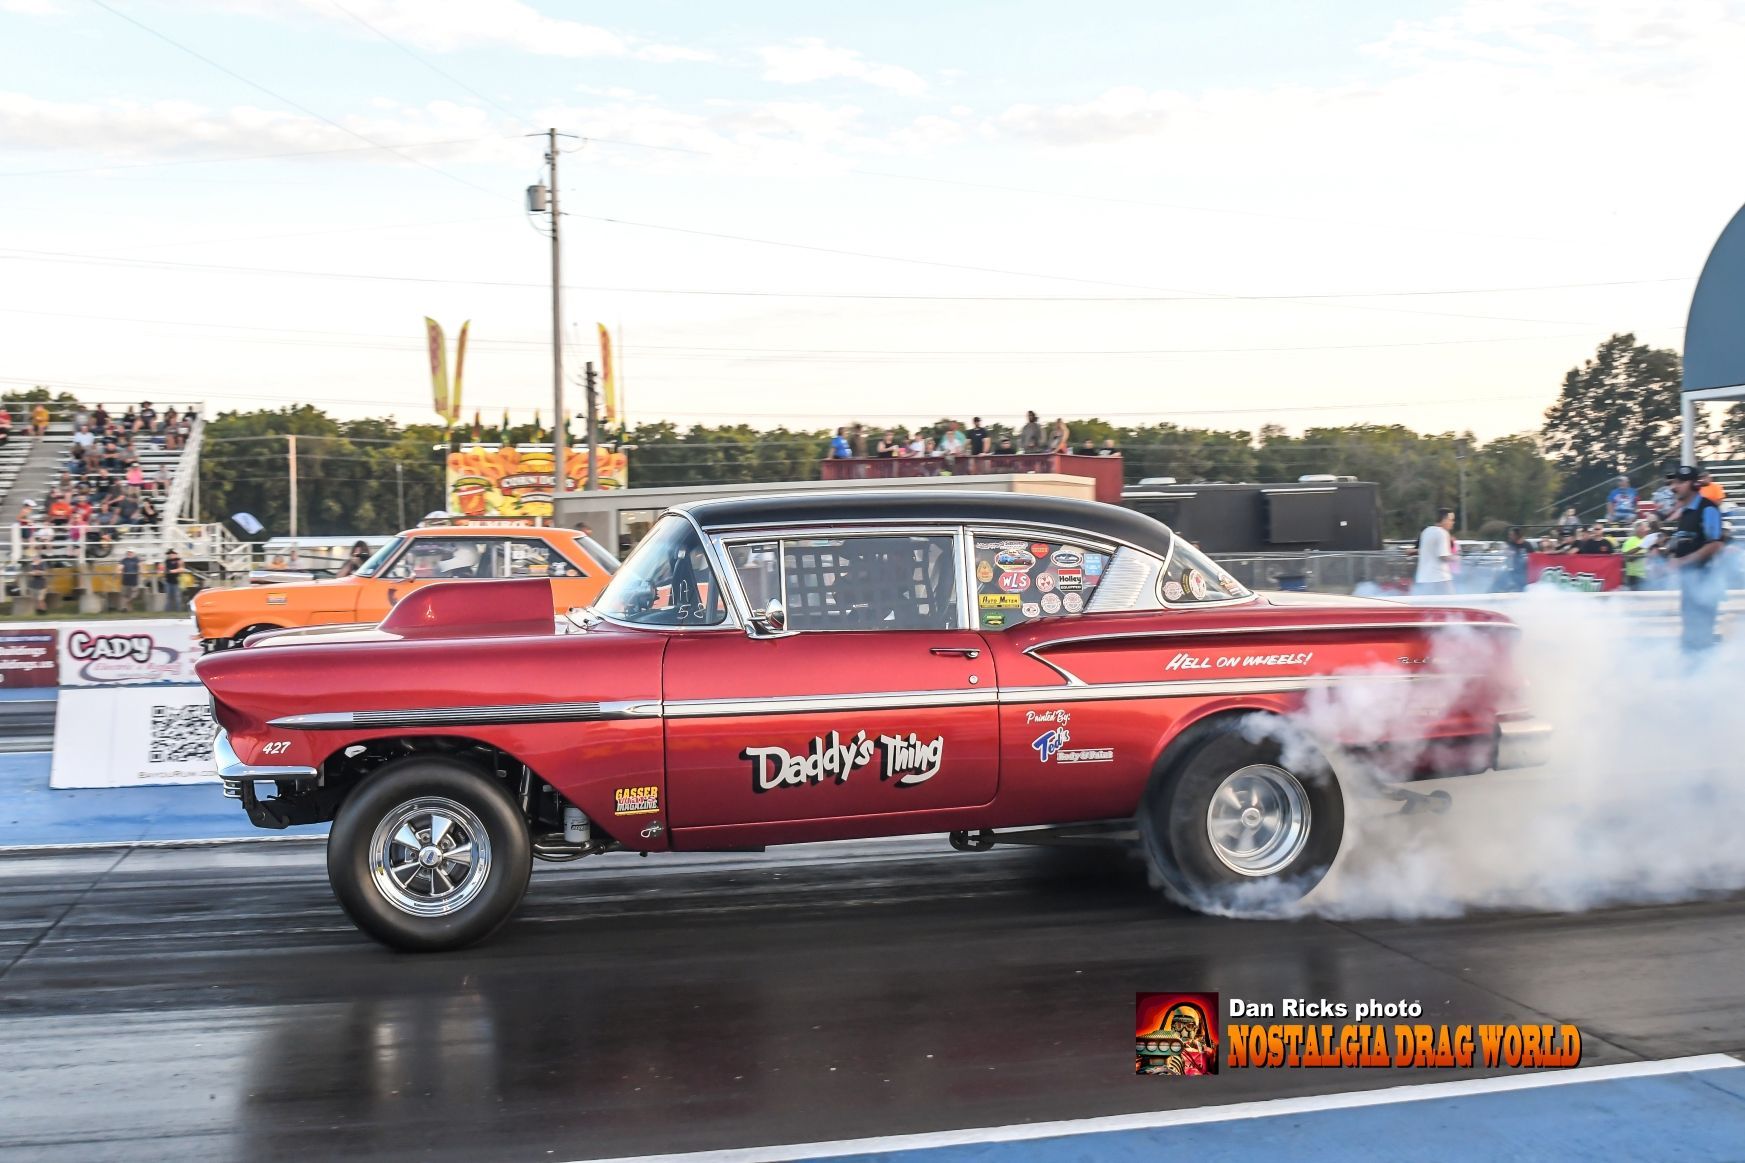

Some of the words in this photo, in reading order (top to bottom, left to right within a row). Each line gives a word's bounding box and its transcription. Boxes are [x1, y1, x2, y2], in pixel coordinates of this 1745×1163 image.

[1003, 573, 1027, 588] WLS
[1059, 576, 1082, 584] Holley
[677, 602, 706, 620] 58
[1165, 653, 1212, 671] HELL
[1216, 656, 1241, 668] ON
[1242, 652, 1313, 667] WHEELS!
[262, 741, 291, 755] 427
[1032, 727, 1070, 762] Ted's
[742, 730, 874, 792] Daddy's
[878, 732, 944, 786] Thing
[615, 786, 658, 800] GASSER
